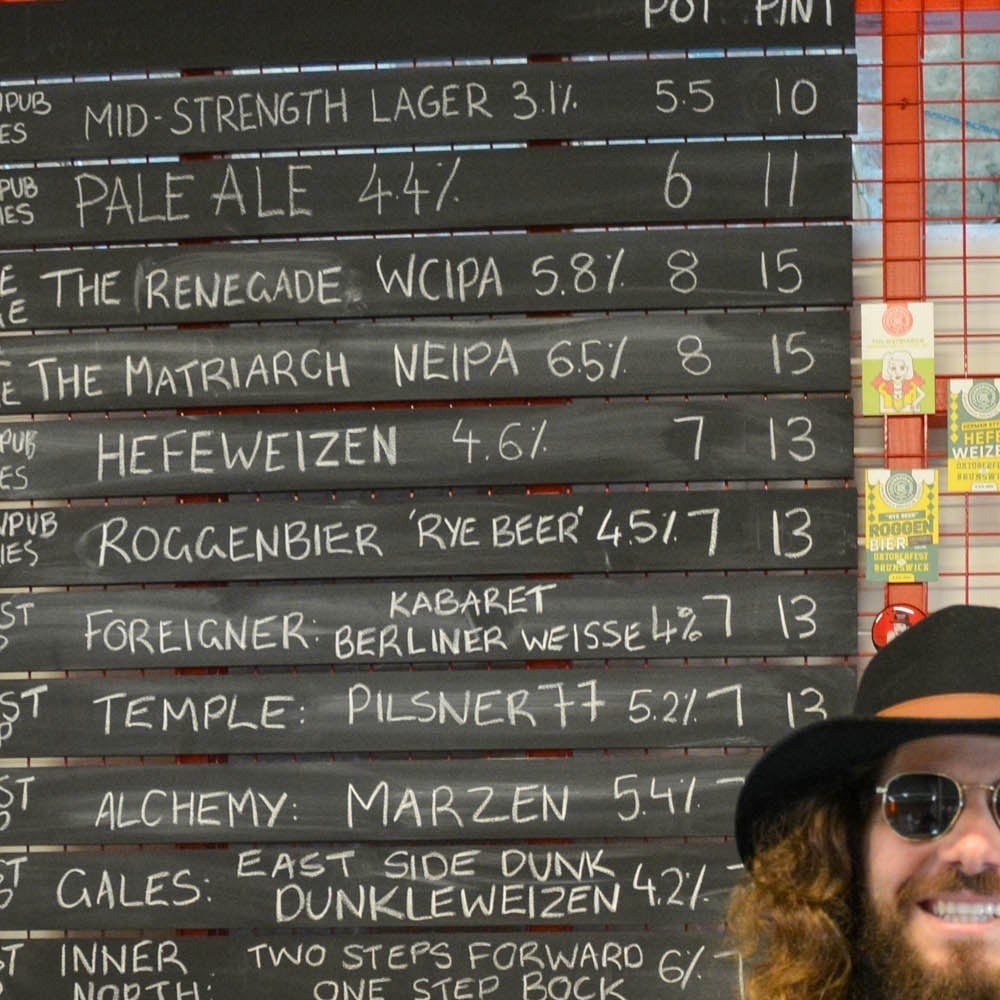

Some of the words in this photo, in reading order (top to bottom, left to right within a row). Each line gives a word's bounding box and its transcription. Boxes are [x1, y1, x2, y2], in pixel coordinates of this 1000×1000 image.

[86, 88, 348, 140] MID-STRENGTH
[372, 83, 493, 122] LAGER
[512, 81, 577, 120] 3.1%
[656, 80, 714, 113] 5.5
[776, 78, 817, 115] 10
[76, 173, 194, 228] PALE
[211, 163, 313, 217] ALE
[359, 158, 460, 215] 4.4%
[664, 151, 692, 208] 6
[765, 152, 797, 207] 11
[40, 268, 121, 307] THE
[146, 266, 342, 310] RENEGADE
[376, 254, 503, 303] WCIPA
[532, 249, 624, 296] 5.8%
[667, 249, 698, 293] 8
[761, 249, 802, 294] 15
[29, 357, 102, 400] THE
[126, 350, 350, 397] MATRIARCH
[394, 338, 518, 387] NEIPA
[547, 336, 628, 382] 6.5%
[677, 335, 711, 375] 8
[772, 332, 814, 375] 15
[98, 425, 397, 481] HEFEWEIZEN
[452, 418, 547, 463] 4.6%
[674, 416, 703, 461] 7
[769, 417, 816, 461] 13
[98, 517, 383, 567] ROGGENBIER
[597, 508, 677, 547] 4.5%
[688, 508, 720, 556] 7
[773, 508, 812, 558] 13
[869, 520, 934, 537] ROGGEN
[870, 537, 906, 552] BIER
[390, 584, 556, 619] KABARET
[85, 610, 320, 654] FOREIGNER:
[335, 624, 507, 659] BERLINER
[522, 622, 646, 652] WEISSE
[651, 605, 702, 644] 4%
[702, 595, 732, 637] 7
[778, 595, 817, 639] 13
[93, 693, 305, 735] TEMPLE:
[628, 688, 697, 726] 5.2%
[706, 684, 743, 726] 7
[95, 788, 298, 830] ALCHEMY:
[347, 782, 568, 829] MARZEN
[614, 774, 700, 821] 5.4%
[237, 850, 355, 878] EAST
[384, 850, 480, 881] SIDE
[501, 849, 615, 881] DUNK
[632, 863, 709, 911] 4.2%
[56, 868, 211, 909] GALES:
[276, 883, 620, 922] DUNKLEWEIZEN
[61, 941, 188, 977] INNER
[248, 943, 325, 969] TWO
[342, 942, 452, 970] STEPS
[468, 942, 643, 970] FORWARD
[658, 946, 704, 990] 6%
